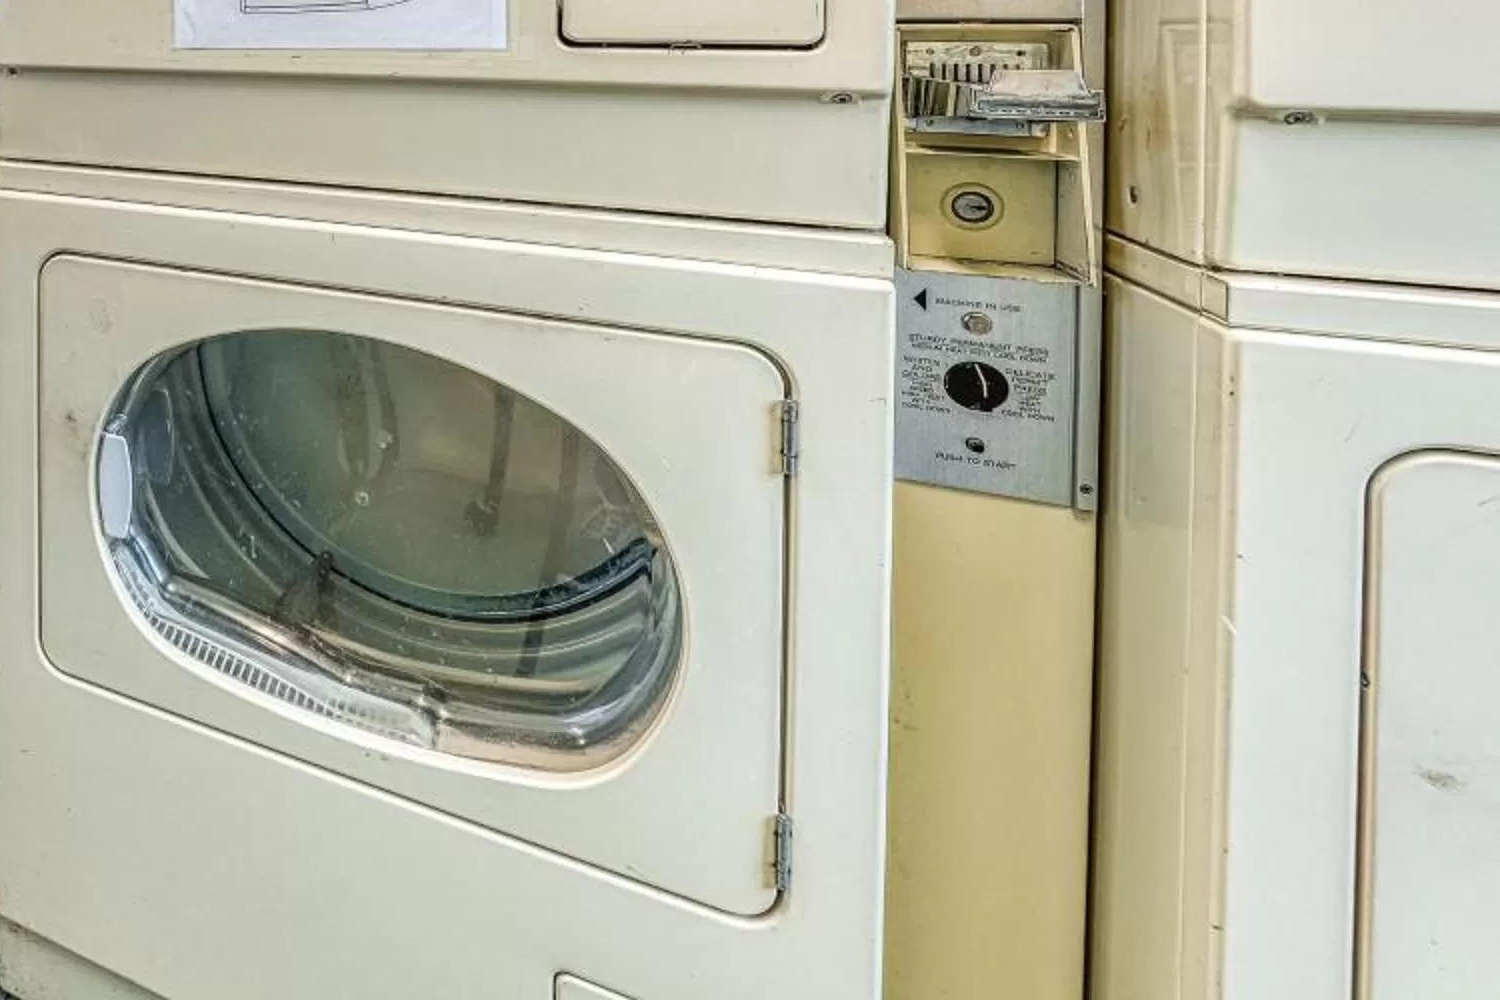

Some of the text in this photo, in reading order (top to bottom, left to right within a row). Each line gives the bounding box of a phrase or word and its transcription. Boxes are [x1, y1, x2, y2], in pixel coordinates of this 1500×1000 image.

[935, 297, 981, 309] MACHINE
[985, 302, 997, 310] IN
[935, 452, 1016, 470] PUSH TO START
